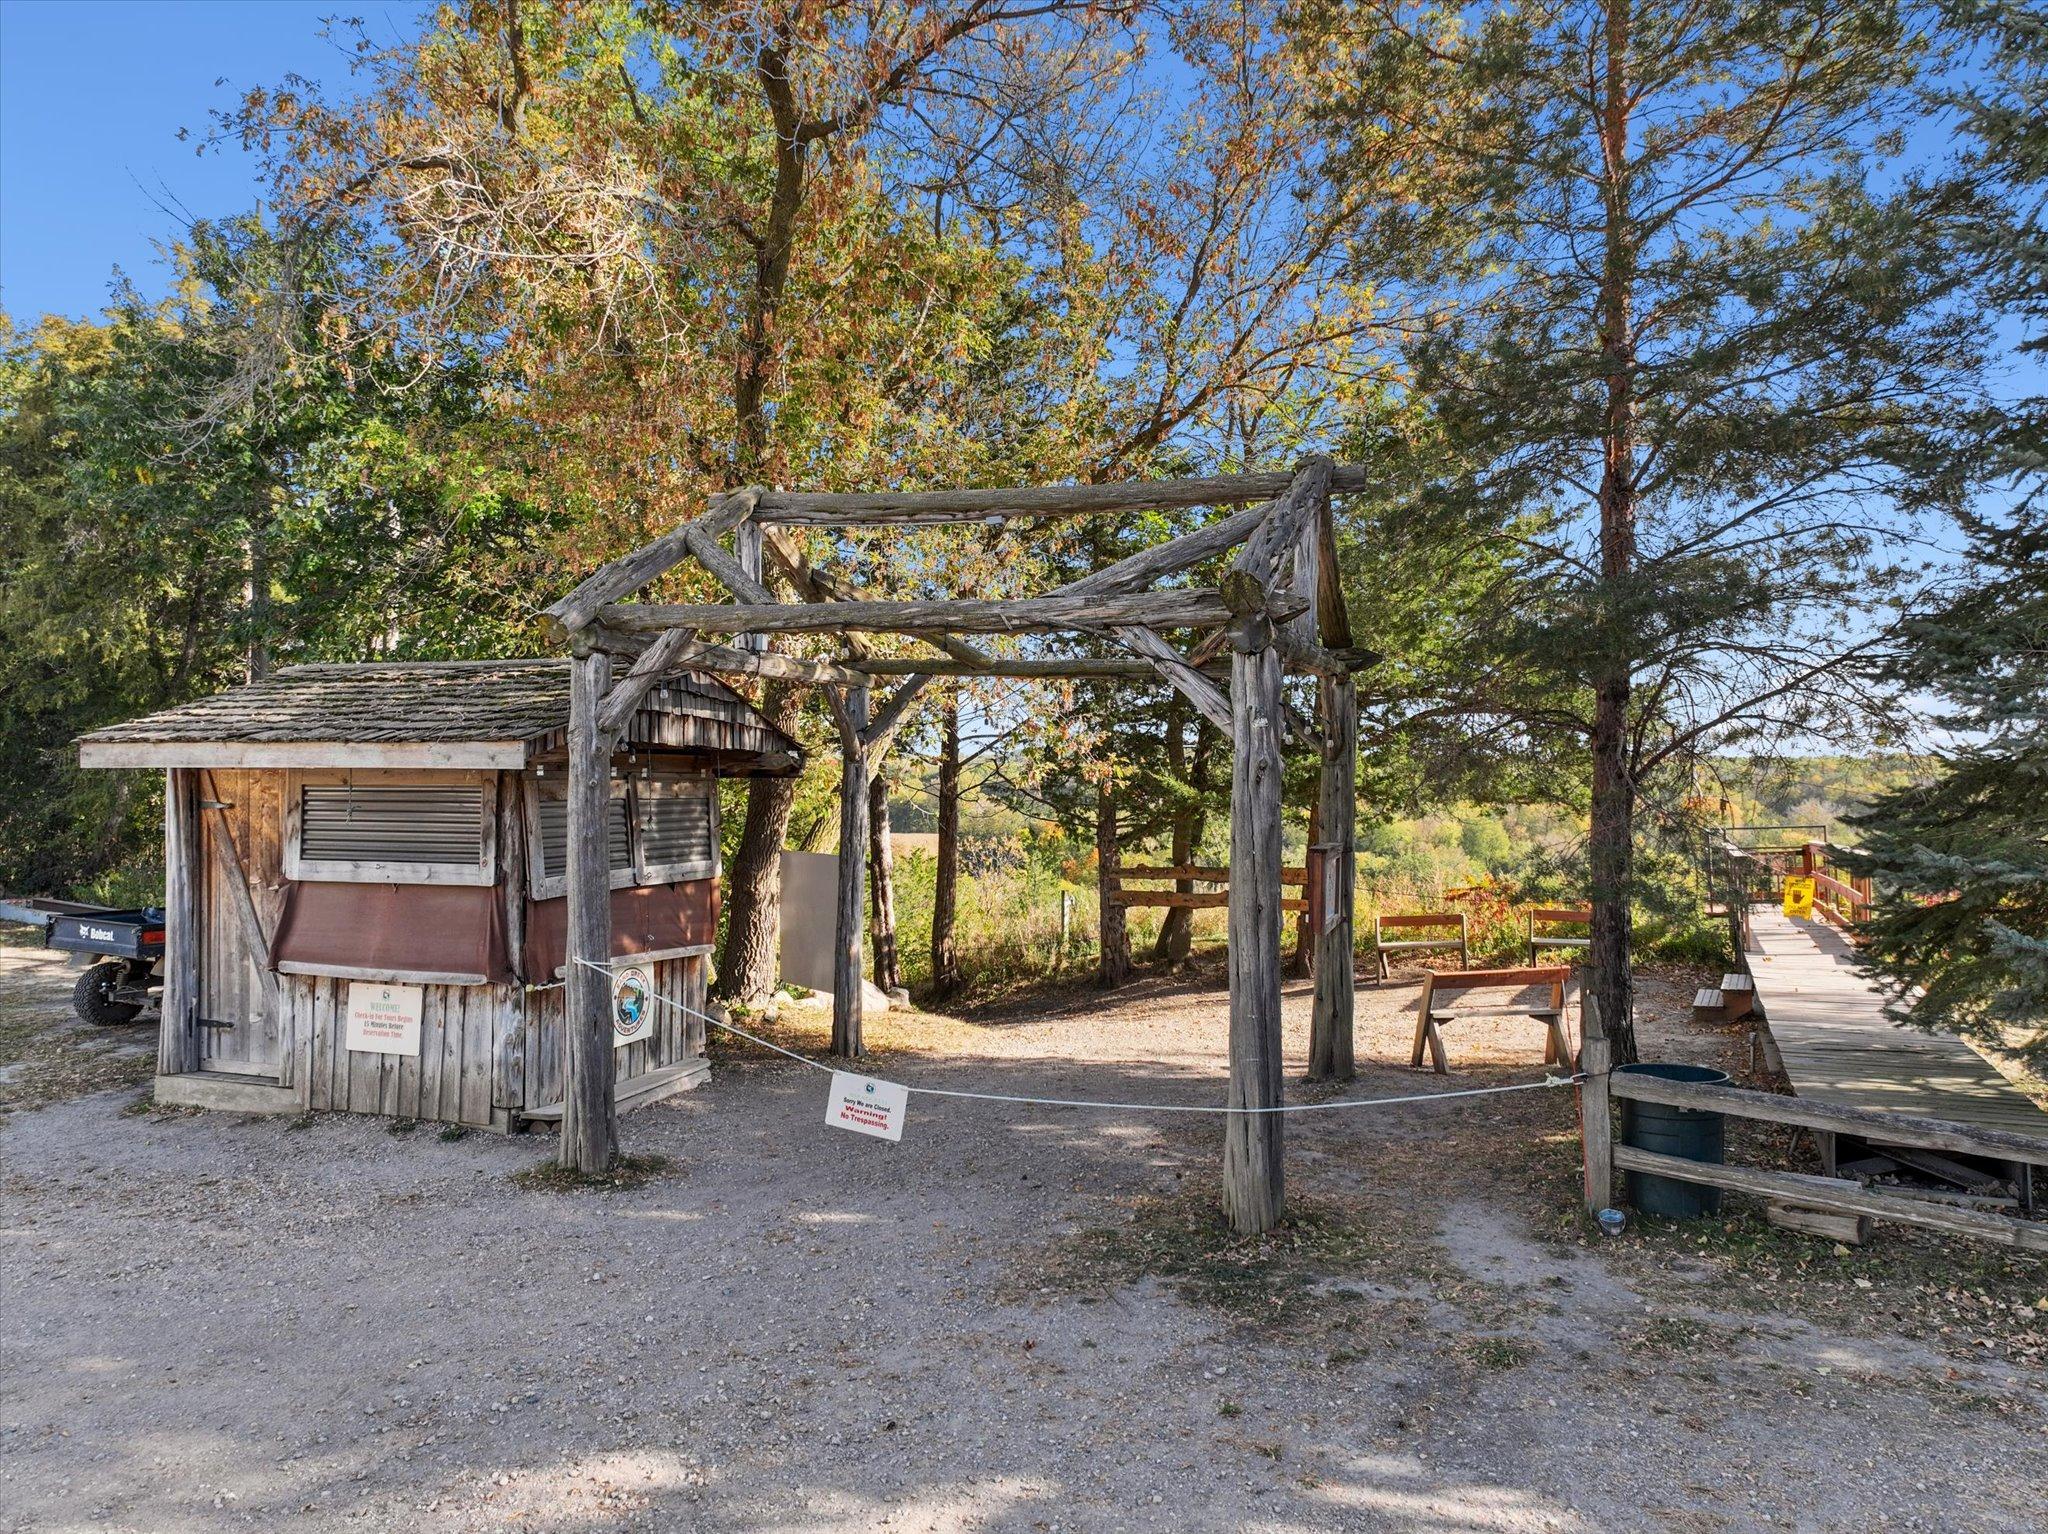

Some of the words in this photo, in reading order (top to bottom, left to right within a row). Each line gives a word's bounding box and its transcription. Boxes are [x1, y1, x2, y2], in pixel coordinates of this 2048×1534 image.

[90, 928, 115, 942] Bobcat
[363, 1028, 390, 1037] Reservation
[388, 1022, 403, 1030] Before
[843, 1096, 856, 1106] Sorry
[873, 1103, 892, 1113] Closed.
[845, 1105, 888, 1120] Warning!
[840, 1111, 849, 1120] No
[850, 1114, 889, 1131] Trespassing.
